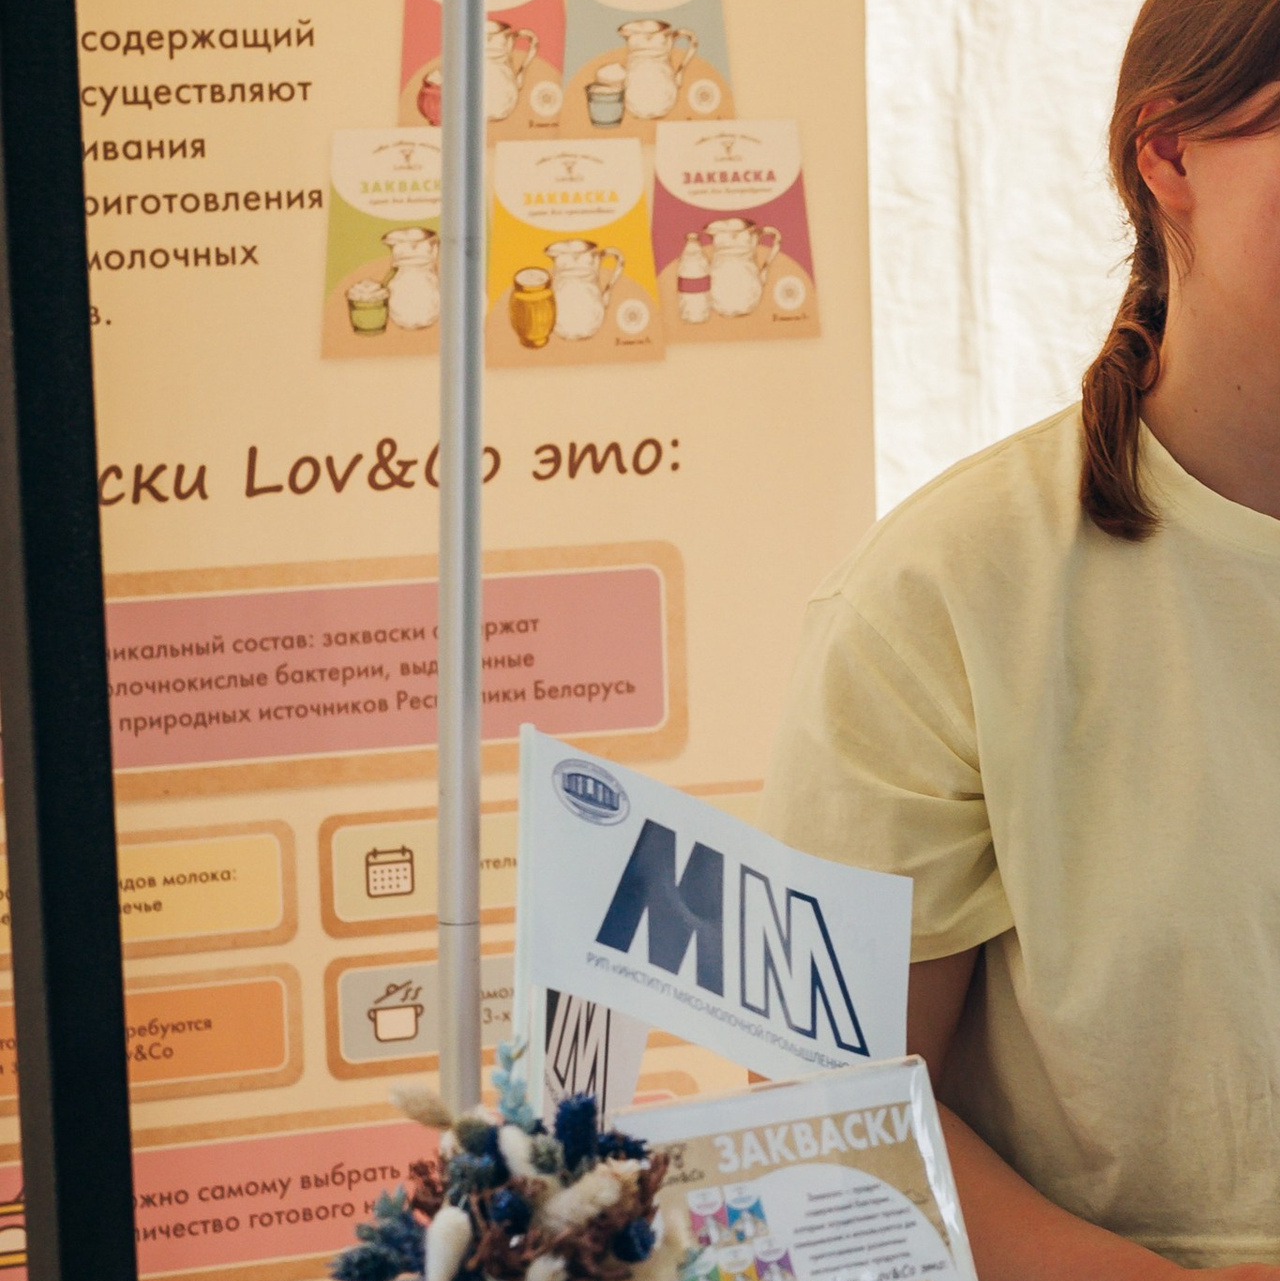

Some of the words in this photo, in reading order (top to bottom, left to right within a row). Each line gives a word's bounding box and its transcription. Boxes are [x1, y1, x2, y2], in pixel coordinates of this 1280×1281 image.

[81, 19, 315, 60] содержащий
[81, 81, 312, 117] существляют
[360, 178, 442, 195] ЗАКВАСК
[682, 169, 777, 186] ЗАКВАСКА
[531, 436, 682, 481] это:
[232, 632, 315, 654] состав:
[322, 624, 426, 648] закваски
[275, 663, 391, 687] бактерии,
[399, 651, 536, 678] выднные
[119, 709, 251, 738] природных
[258, 696, 389, 723] источников
[395, 684, 526, 711] Ресики
[533, 679, 637, 703] Беларусь
[162, 868, 238, 888] молока:
[713, 1101, 919, 1174] ЗАКВАСКИ
[197, 1175, 291, 1200] самому
[300, 1162, 401, 1191] выбрать
[248, 1200, 355, 1230] готового
